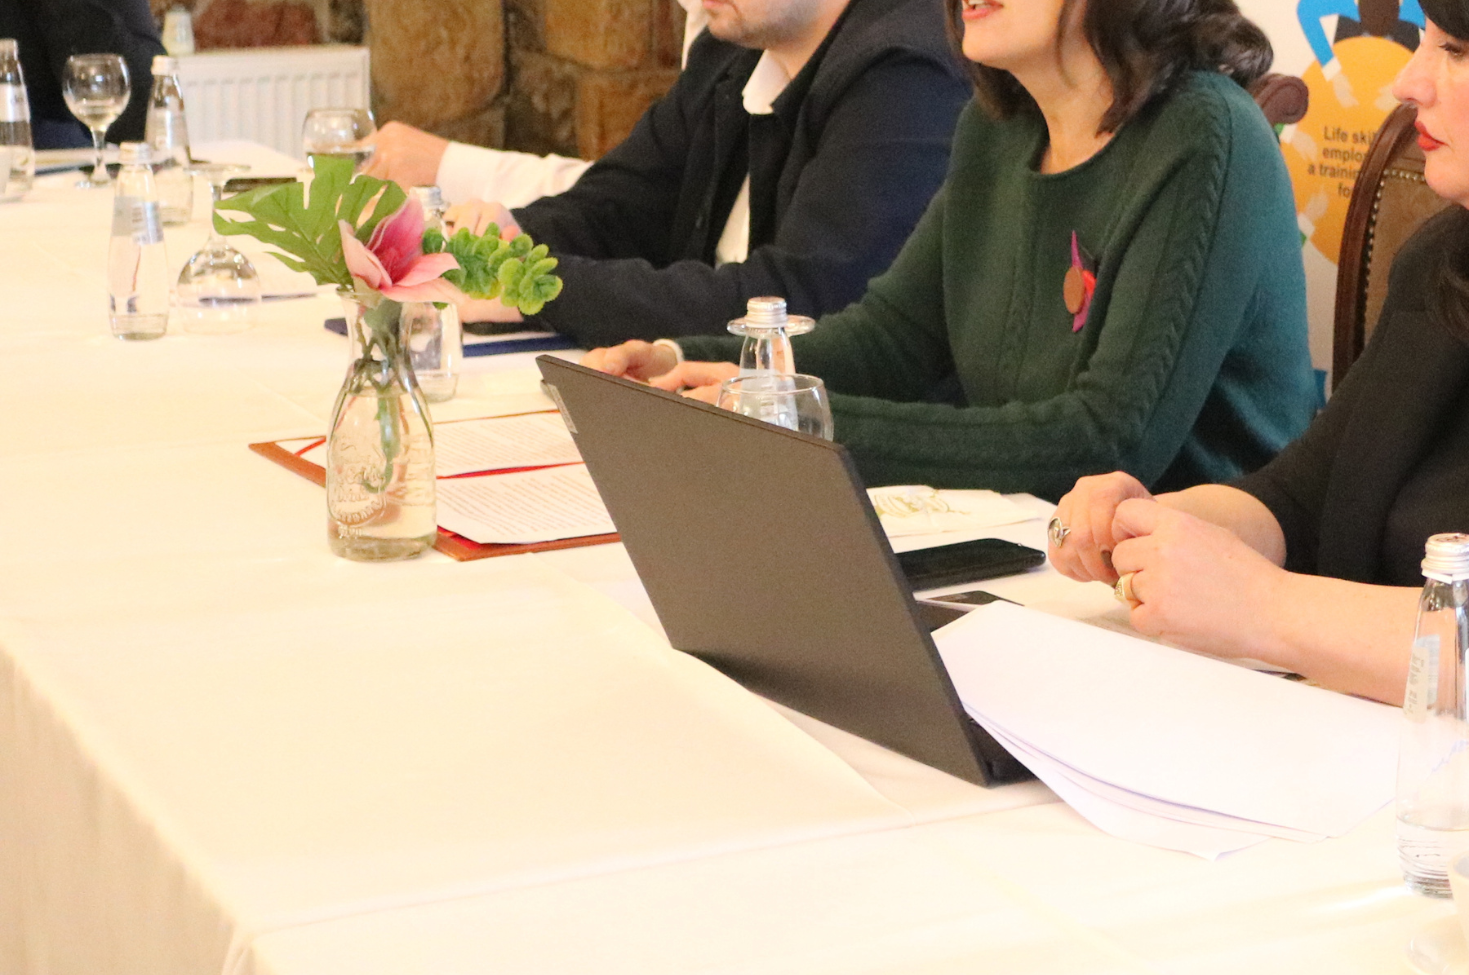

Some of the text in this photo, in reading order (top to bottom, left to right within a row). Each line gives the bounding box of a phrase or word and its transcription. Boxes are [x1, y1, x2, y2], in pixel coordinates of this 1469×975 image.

[1324, 126, 1348, 142] Life
[1322, 147, 1366, 164] emplo
[1308, 165, 1315, 175] a
[1338, 183, 1352, 197] fo
